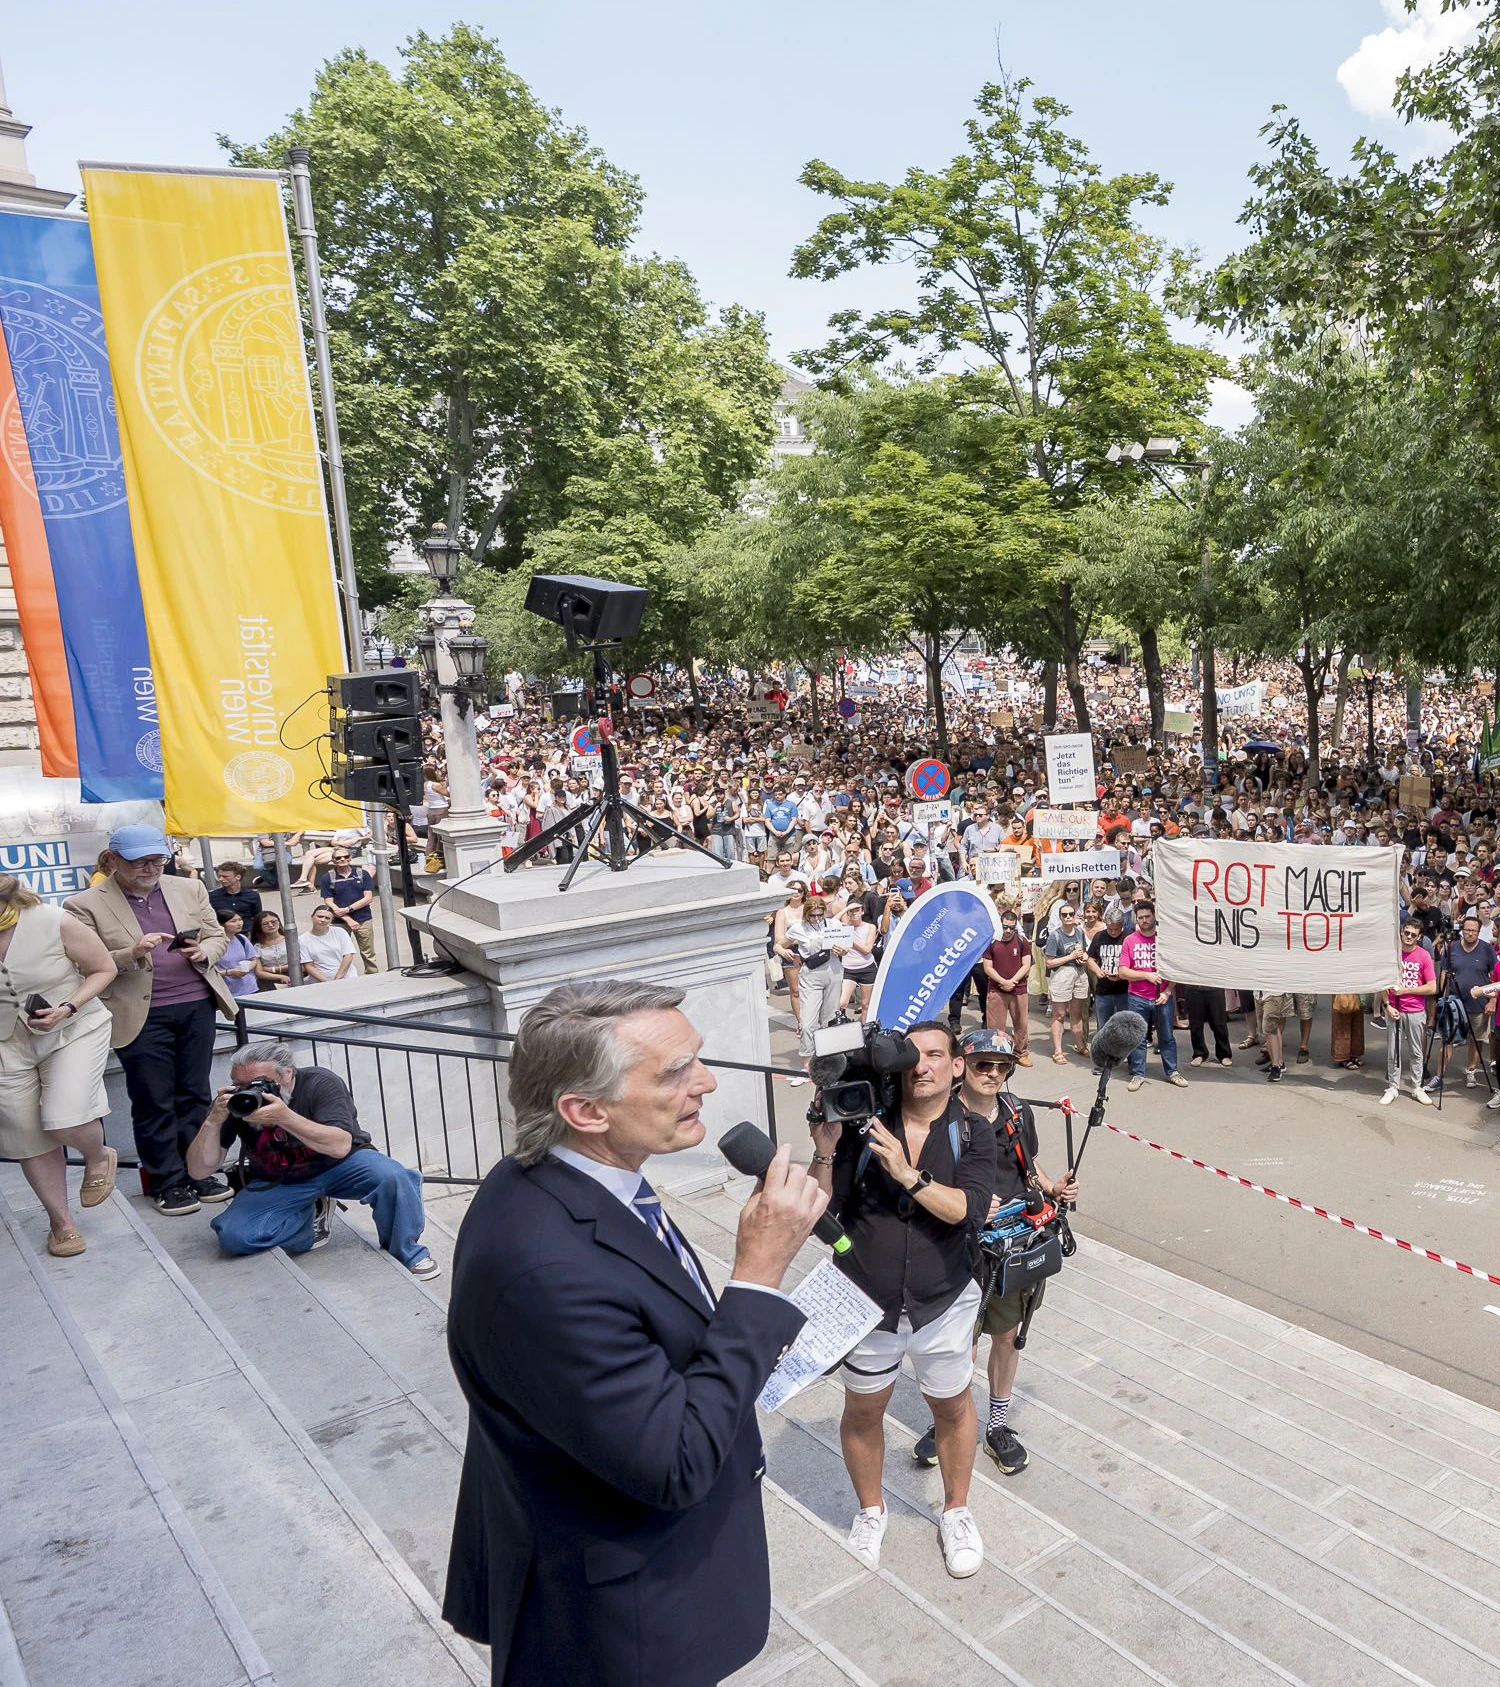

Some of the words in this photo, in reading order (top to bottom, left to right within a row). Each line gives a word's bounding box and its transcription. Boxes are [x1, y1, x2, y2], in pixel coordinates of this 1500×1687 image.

[1057, 768, 1089, 776] Richtige
[1041, 812, 1065, 824] SAVE
[1069, 813, 1090, 826] OUR
[1, 842, 69, 870] UNI
[1048, 863, 1118, 874] #UnisRetten
[1192, 858, 1275, 907] ROT
[1285, 865, 1366, 913] MACHT
[1194, 905, 1260, 949] UNIS
[1277, 911, 1354, 952] TOT
[1035, 1209, 1053, 1226] ORF
